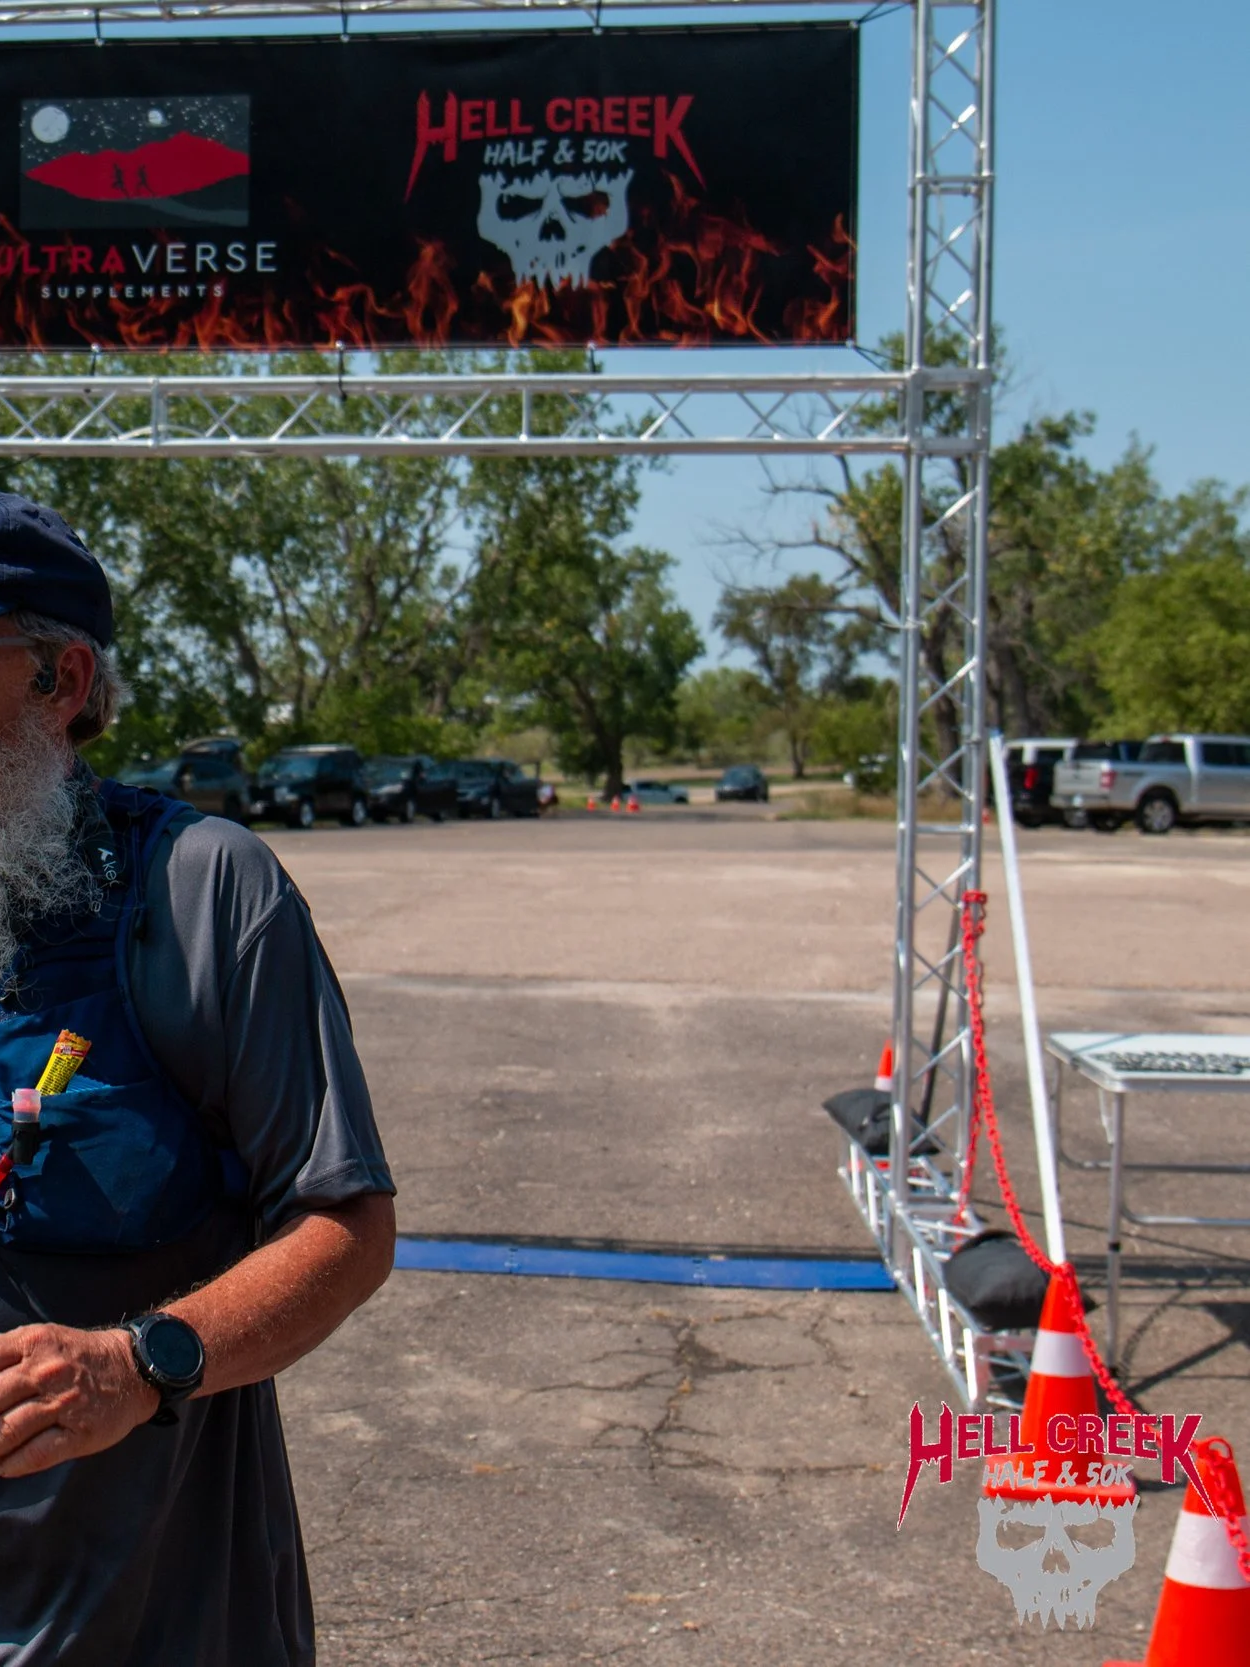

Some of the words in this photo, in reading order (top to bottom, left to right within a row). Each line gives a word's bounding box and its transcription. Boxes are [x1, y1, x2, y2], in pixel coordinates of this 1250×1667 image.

[404, 89, 534, 204] HELL
[545, 95, 707, 192] CREEK
[483, 140, 547, 166] HALF
[553, 139, 576, 165] &
[583, 139, 628, 164] 50K
[40, 282, 225, 299] SUPPLEMENTS
